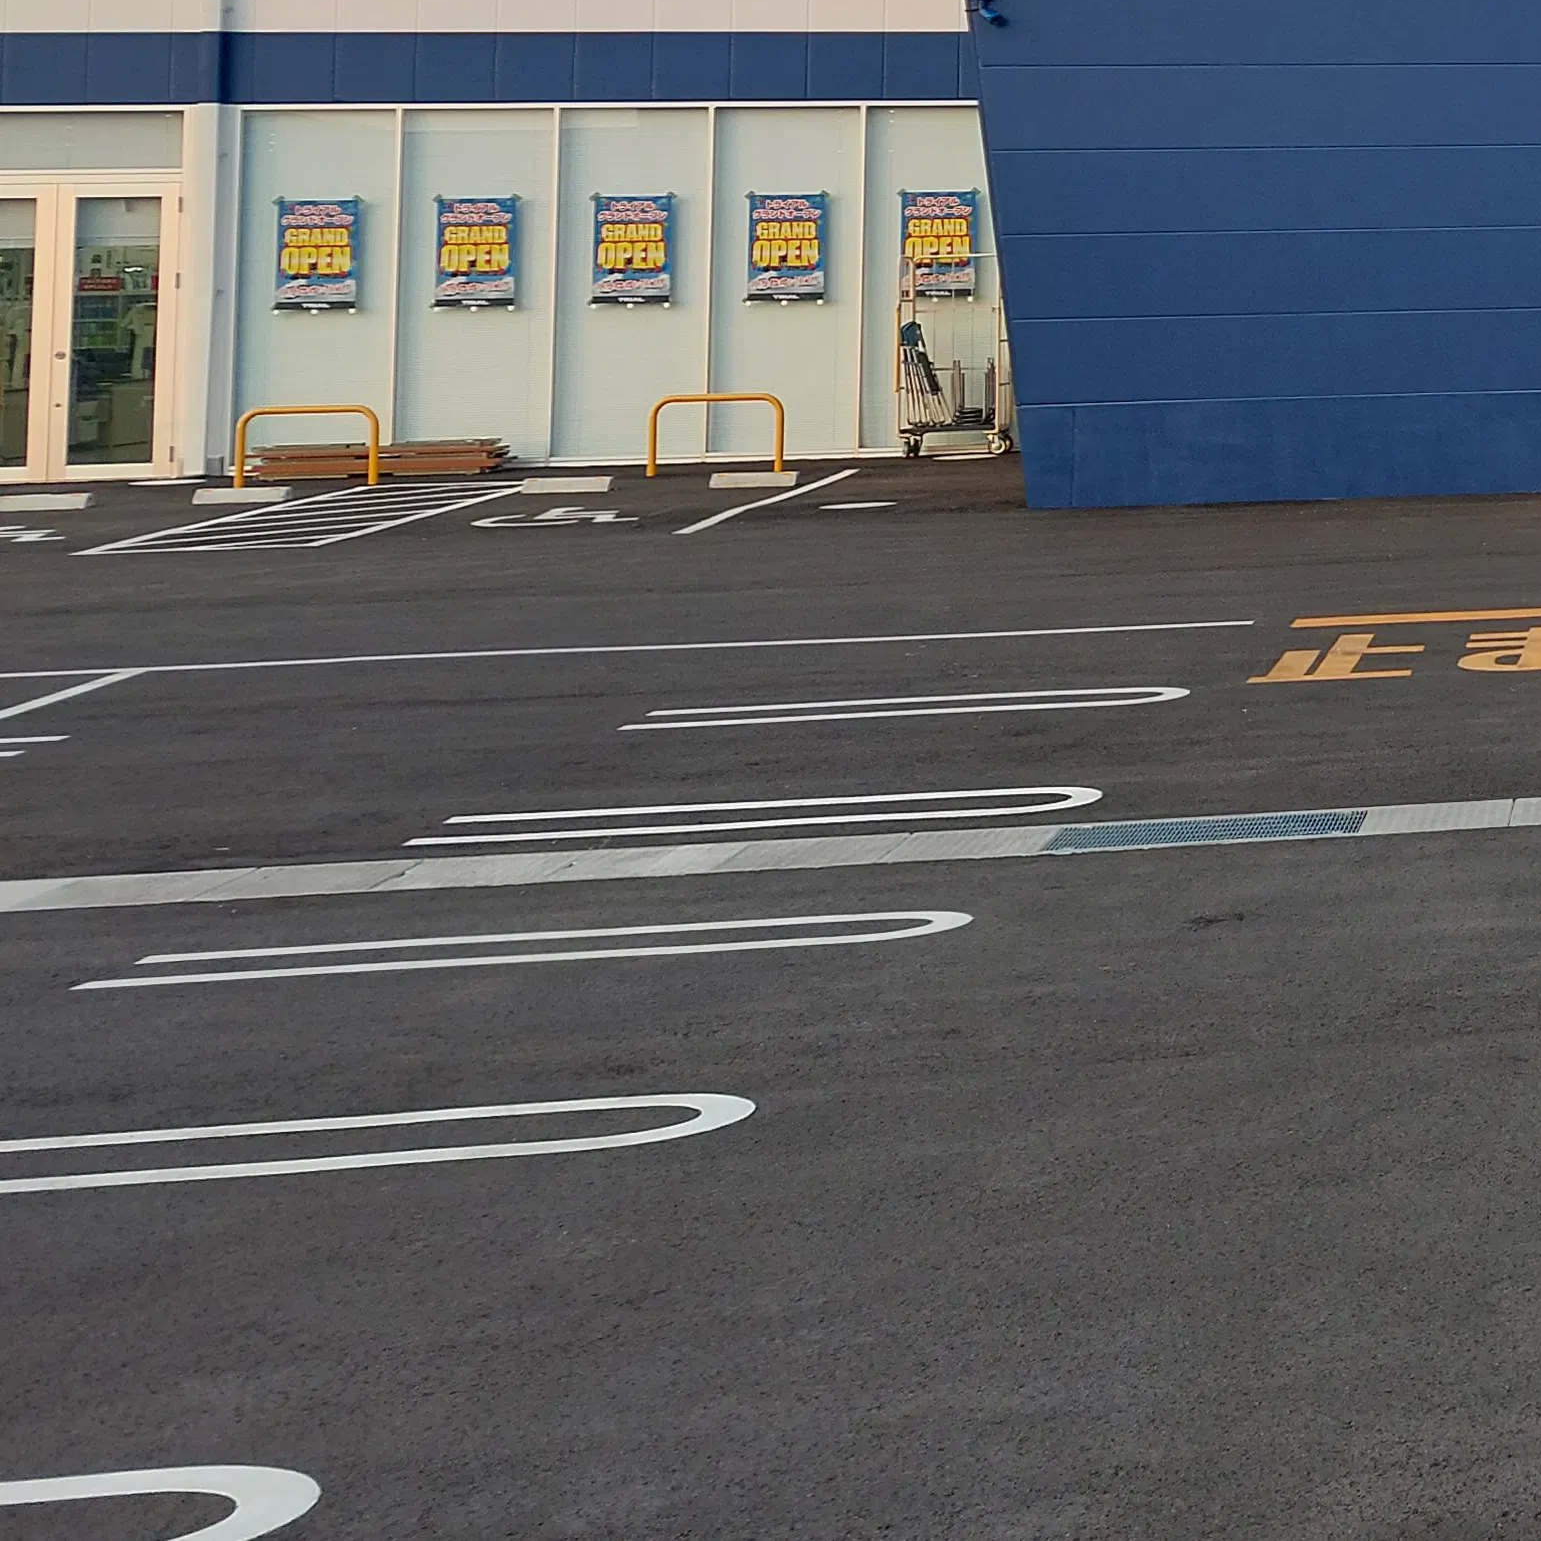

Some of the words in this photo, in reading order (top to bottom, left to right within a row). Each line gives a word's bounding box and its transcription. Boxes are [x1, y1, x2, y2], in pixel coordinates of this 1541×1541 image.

[765, 199, 809, 209] トライアル
[917, 197, 960, 206] トライアル
[444, 226, 507, 244] GRAND
[601, 224, 662, 241] GRAND
[756, 222, 816, 239] GRAND
[908, 218, 968, 236] GRAND
[285, 228, 349, 246] GRAND
[440, 244, 510, 272] OPEN
[597, 242, 666, 268] OPEN
[752, 239, 820, 266] OPEN
[905, 237, 970, 263] OPEN
[280, 246, 351, 274] OPEN
